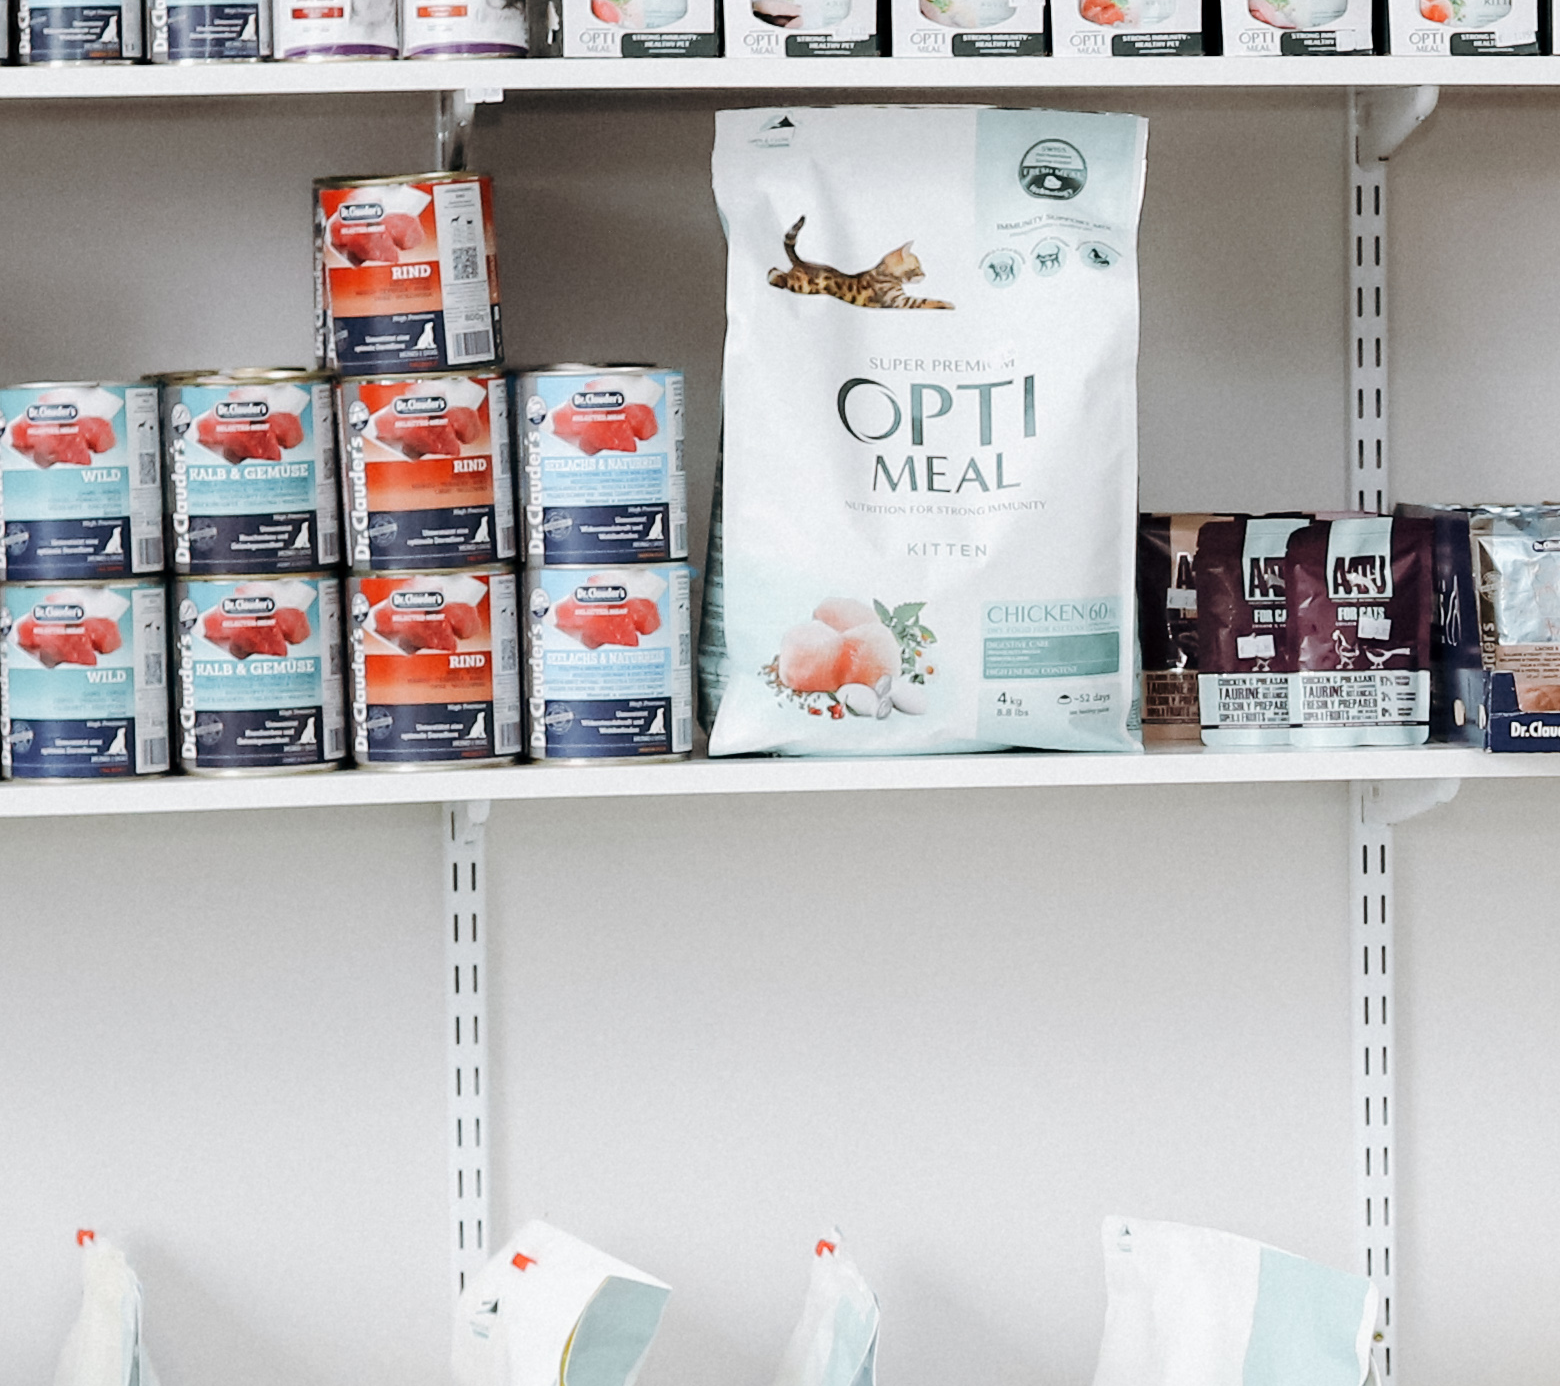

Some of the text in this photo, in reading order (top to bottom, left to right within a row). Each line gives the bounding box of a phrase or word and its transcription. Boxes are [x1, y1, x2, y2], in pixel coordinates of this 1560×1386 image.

[391, 264, 431, 280] RIND
[870, 357, 1016, 371] SUPER PREMIM
[837, 375, 1036, 445] OPTI
[189, 467, 226, 481] KALB
[242, 463, 308, 479] GEMÜSE
[453, 459, 487, 473] RIND
[872, 453, 1020, 493] MEAL
[81, 470, 121, 483] WILD
[844, 499, 1047, 517] NUTRITION FOR STRONG IMMUNITY
[907, 543, 987, 557] KITTEN
[987, 604, 1085, 624] CHICKEN
[449, 655, 485, 669] RIND
[86, 670, 127, 683] WILD
[997, 692, 1022, 707] 4 kg
